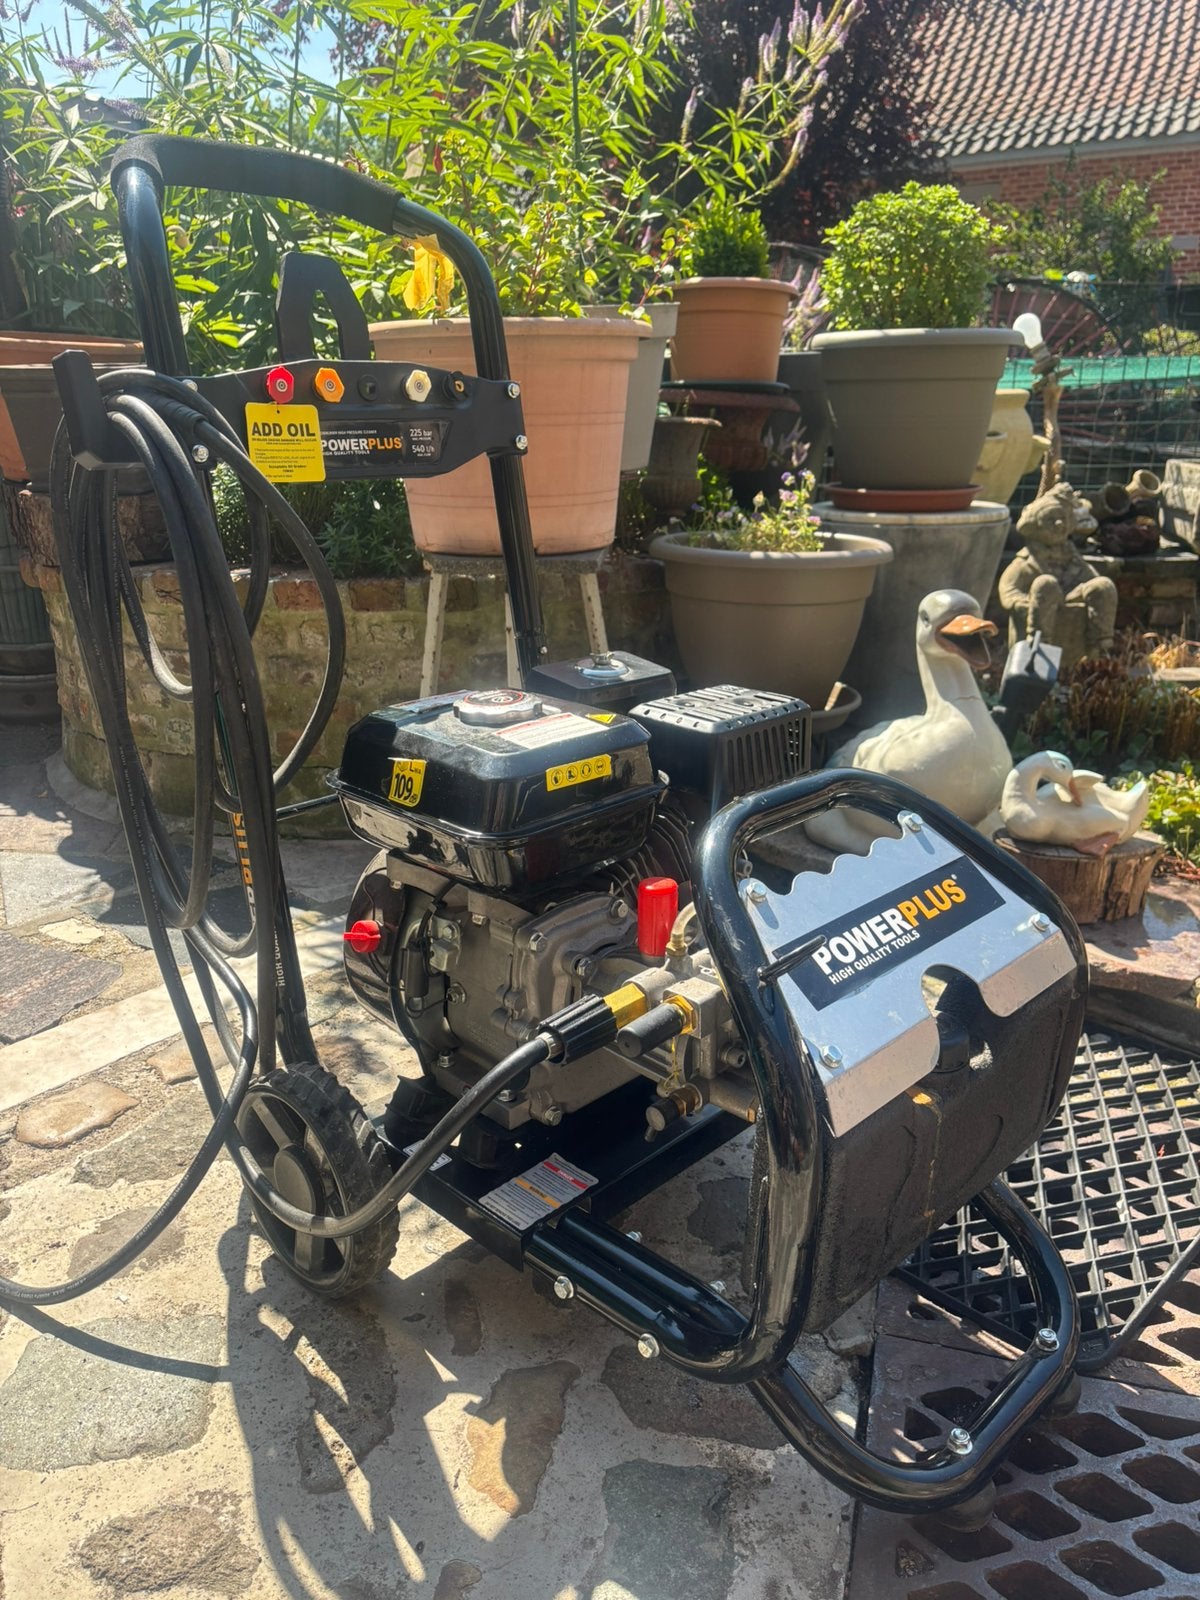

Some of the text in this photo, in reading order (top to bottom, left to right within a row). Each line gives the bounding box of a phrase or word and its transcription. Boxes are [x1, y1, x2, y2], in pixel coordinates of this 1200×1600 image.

[252, 422, 316, 437] ADD OIL
[409, 429, 422, 437] 225
[320, 437, 402, 451] POWERPLUS
[411, 444, 425, 453] 540
[393, 773, 414, 800] 109
[811, 878, 967, 976] POWERPLUS
[829, 929, 921, 985] HIGH QUALITY TOOLS
[274, 958, 285, 987] HIGH
